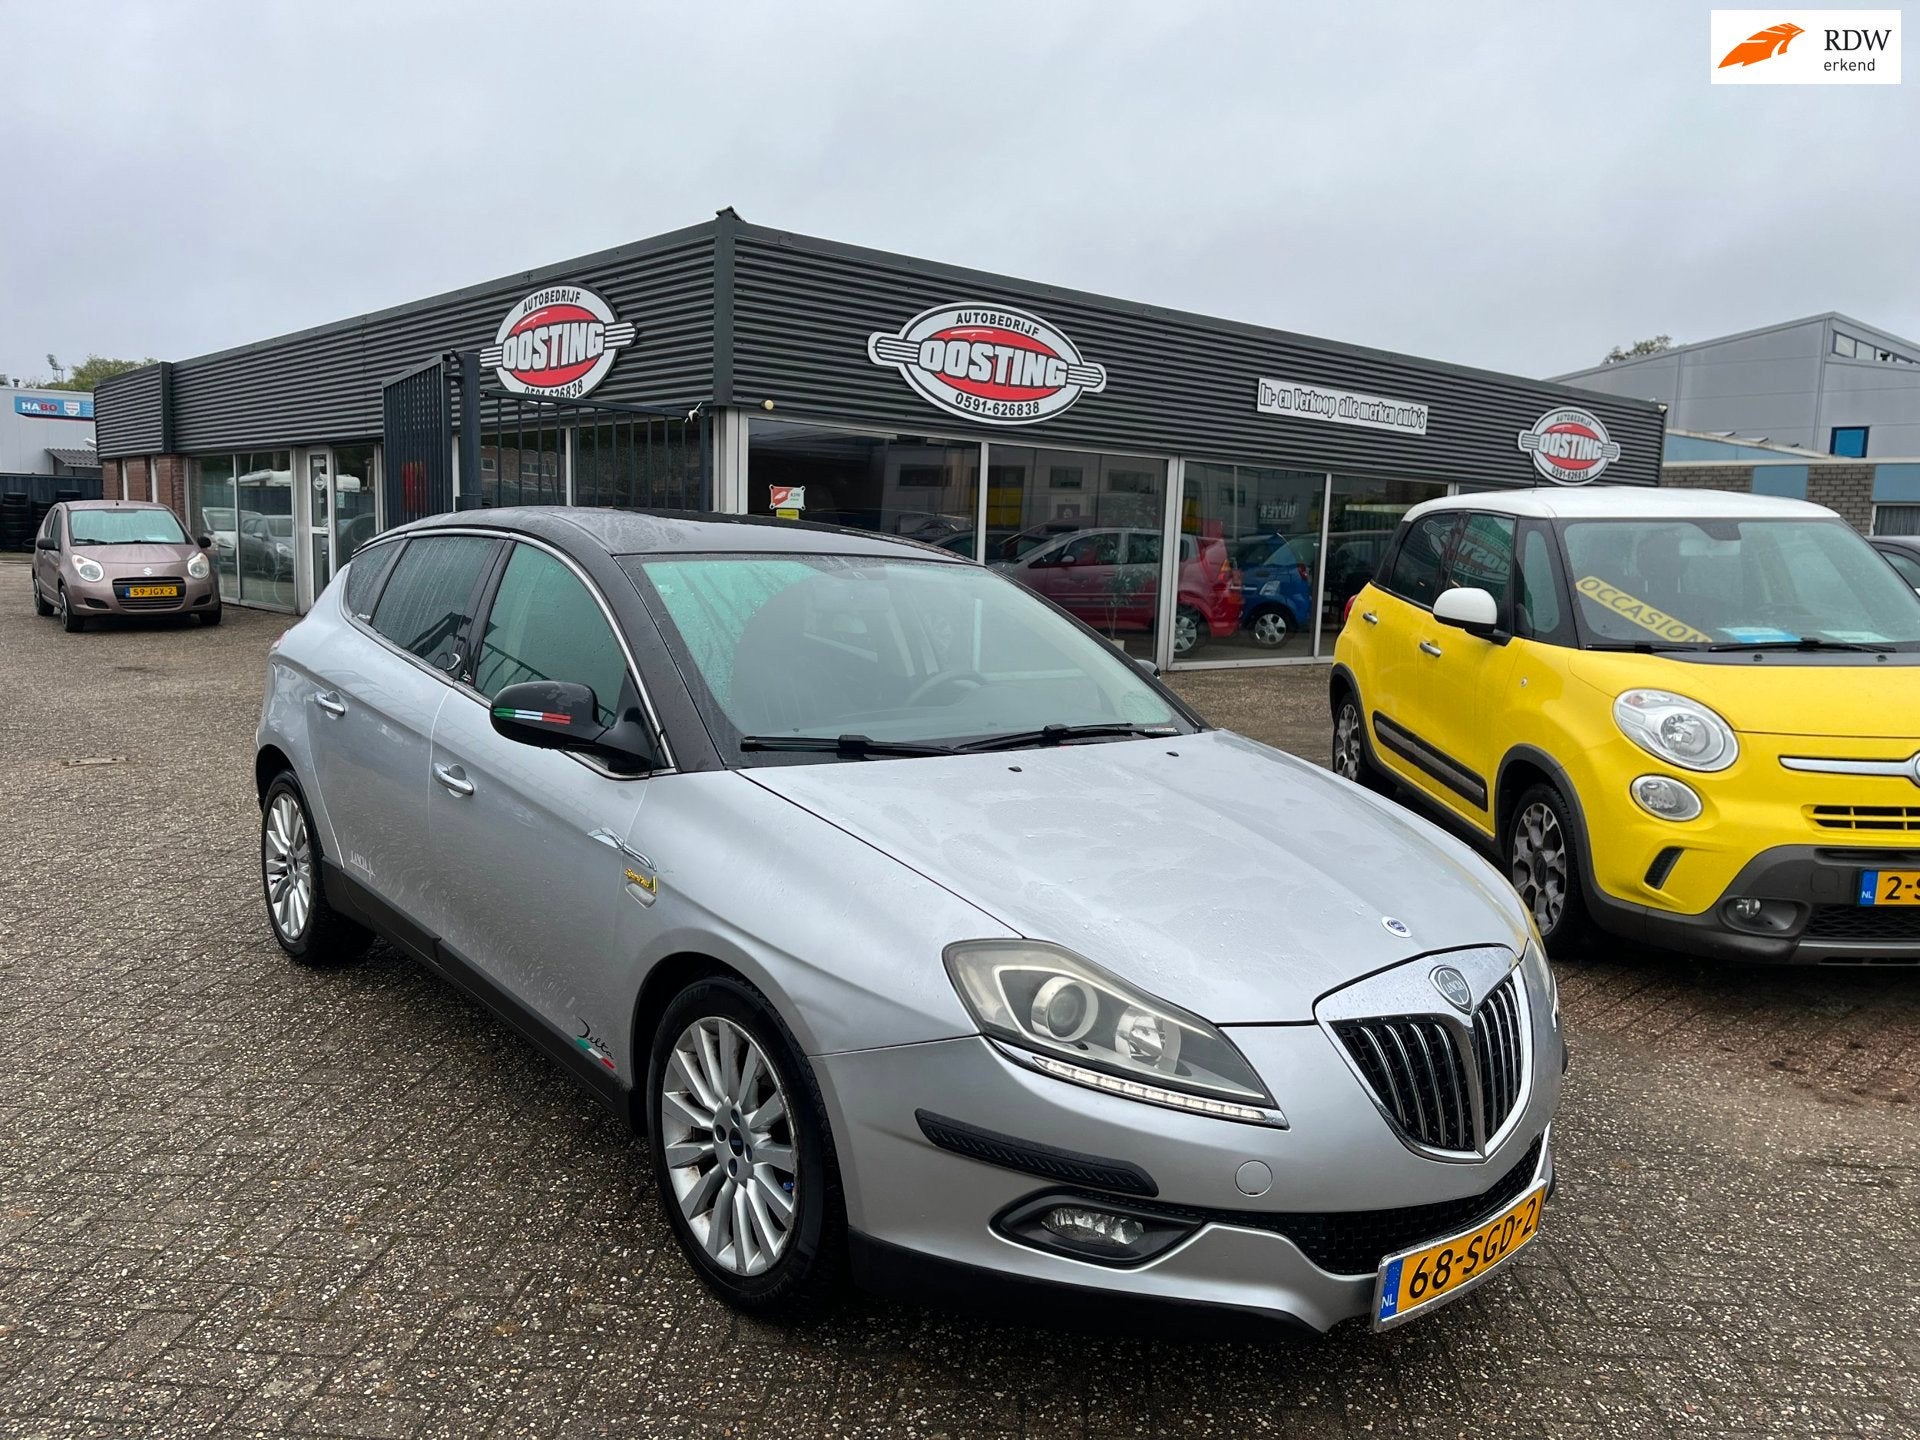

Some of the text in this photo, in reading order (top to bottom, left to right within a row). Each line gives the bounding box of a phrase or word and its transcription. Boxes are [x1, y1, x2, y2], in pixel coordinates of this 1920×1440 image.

[522, 289, 581, 315] AUTOBEDRIJF
[955, 312, 1040, 337] AUTOBEDRIJF
[502, 319, 605, 371] OOSTING
[918, 338, 1069, 389] OOSTING
[955, 392, 1040, 416] 0591-626838
[1260, 383, 1425, 429] In- en Verkoop alle merken auto's
[1539, 432, 1603, 461] OOSTING
[1861, 890, 1873, 899] NL
[1409, 1197, 1537, 1299] 68-SGD-2
[1381, 1296, 1395, 1309] NL
